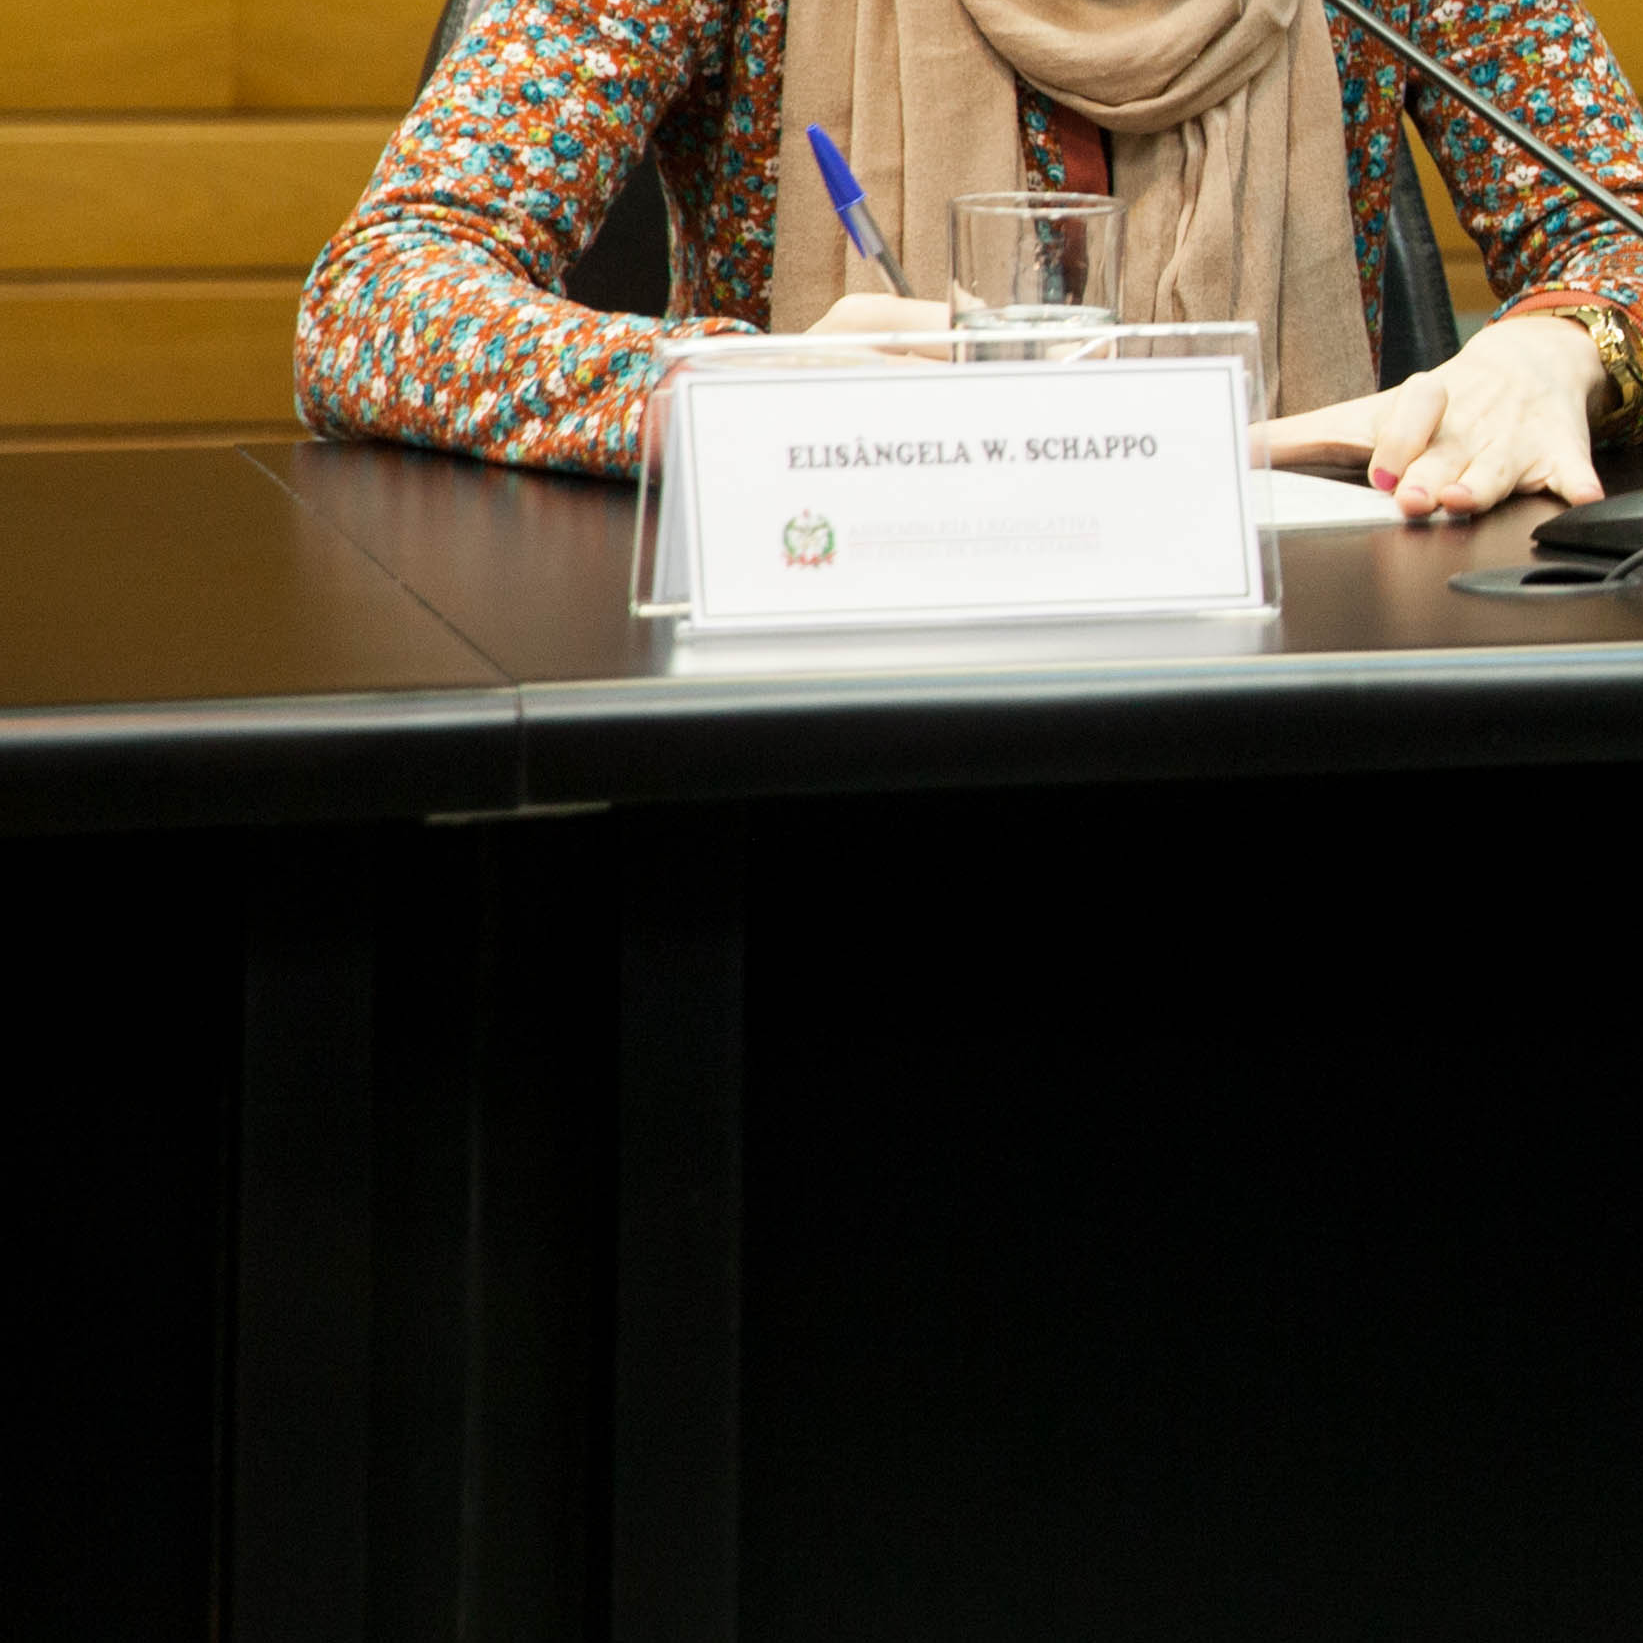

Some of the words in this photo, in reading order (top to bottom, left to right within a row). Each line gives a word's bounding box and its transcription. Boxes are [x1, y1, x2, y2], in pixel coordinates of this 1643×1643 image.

[787, 436, 972, 470] ELISÂNGELA
[981, 439, 1016, 462] W.
[1024, 434, 1159, 462] SCHAPPO
